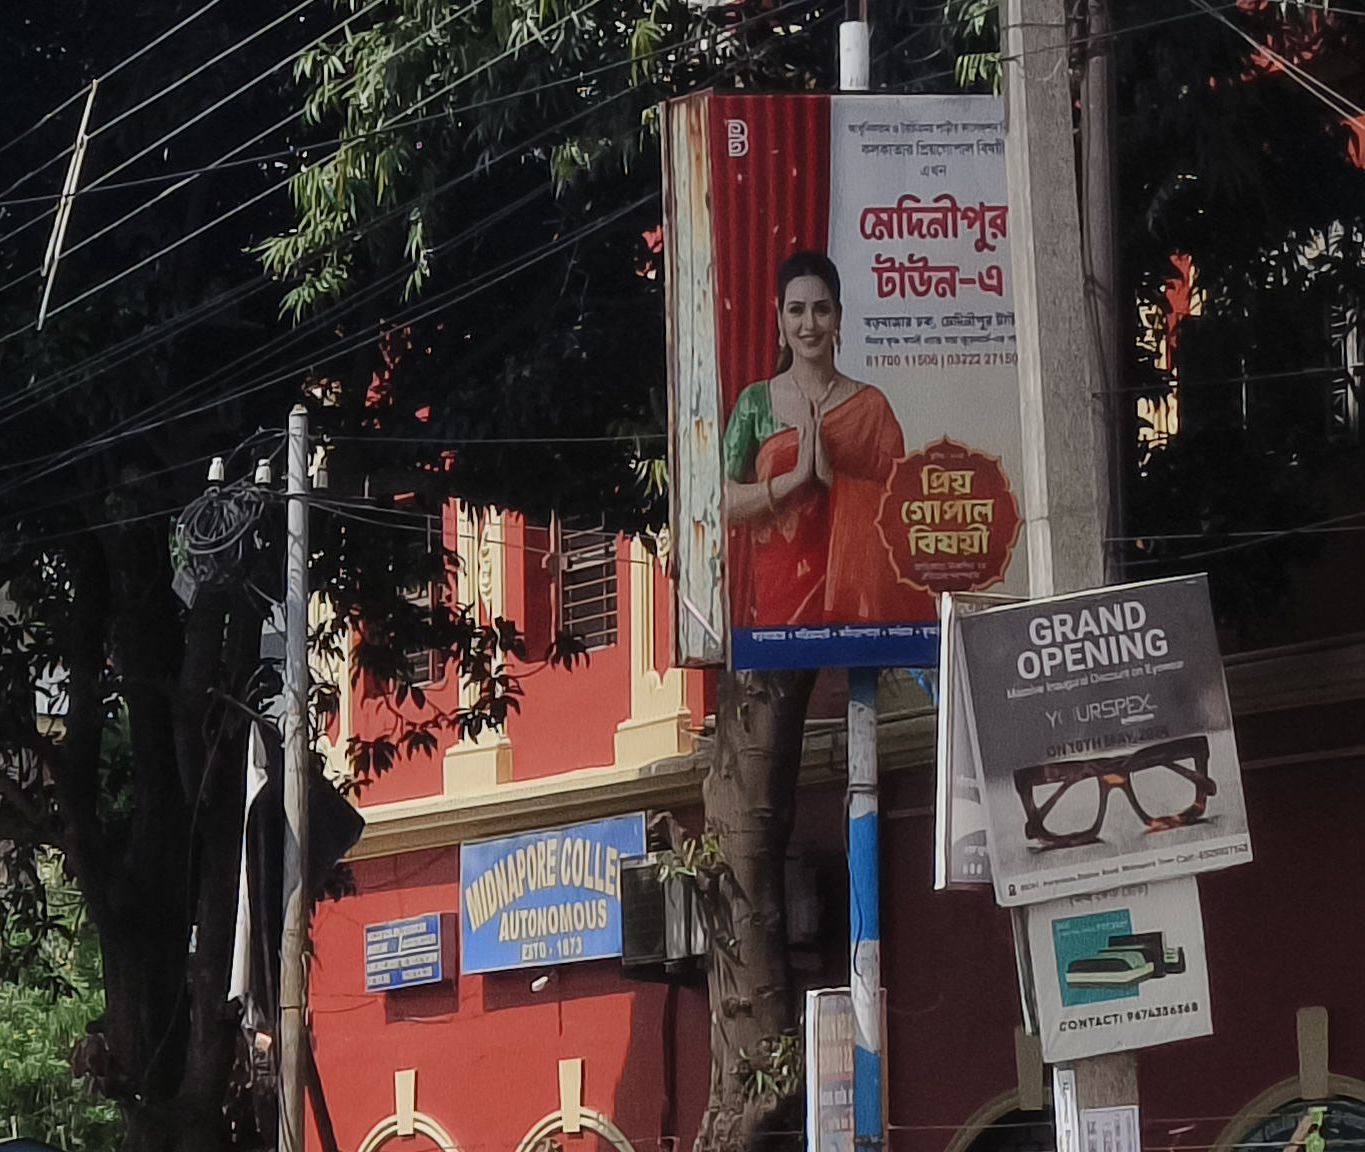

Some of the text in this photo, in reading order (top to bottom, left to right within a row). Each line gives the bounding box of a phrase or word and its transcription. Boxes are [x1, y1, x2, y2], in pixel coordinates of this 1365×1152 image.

[859, 193, 1009, 252] মেদিনীপুর
[871, 253, 1004, 299] টাউন-এ
[921, 464, 975, 496] প্রিয়
[901, 499, 995, 524] গোপাল
[908, 524, 990, 556] বিষয়ী
[1029, 601, 1147, 646] GRAND
[1017, 629, 1169, 680] OPENING
[465, 838, 621, 934] MIDNAPORE COLLE
[498, 899, 607, 943] AUTONOMOUS
